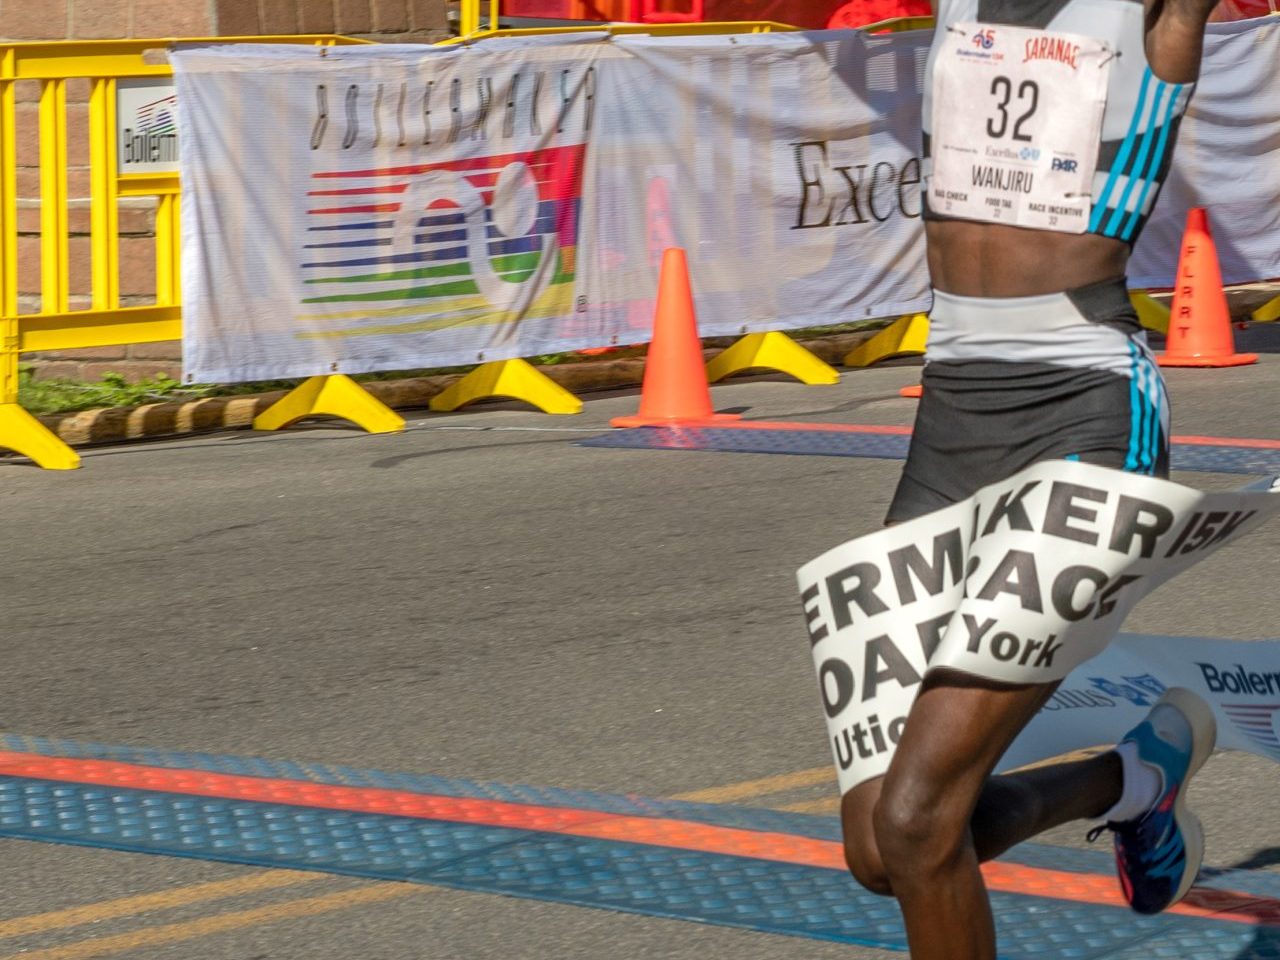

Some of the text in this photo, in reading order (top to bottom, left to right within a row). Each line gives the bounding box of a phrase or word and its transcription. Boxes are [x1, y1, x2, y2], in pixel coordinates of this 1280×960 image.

[986, 75, 1039, 143] 32
[946, 191, 968, 202] CHECK
[972, 164, 1034, 194] WANJIRU
[1048, 206, 1083, 217] INCENTIVE
[971, 480, 1175, 559] KER
[961, 613, 1062, 668] York
